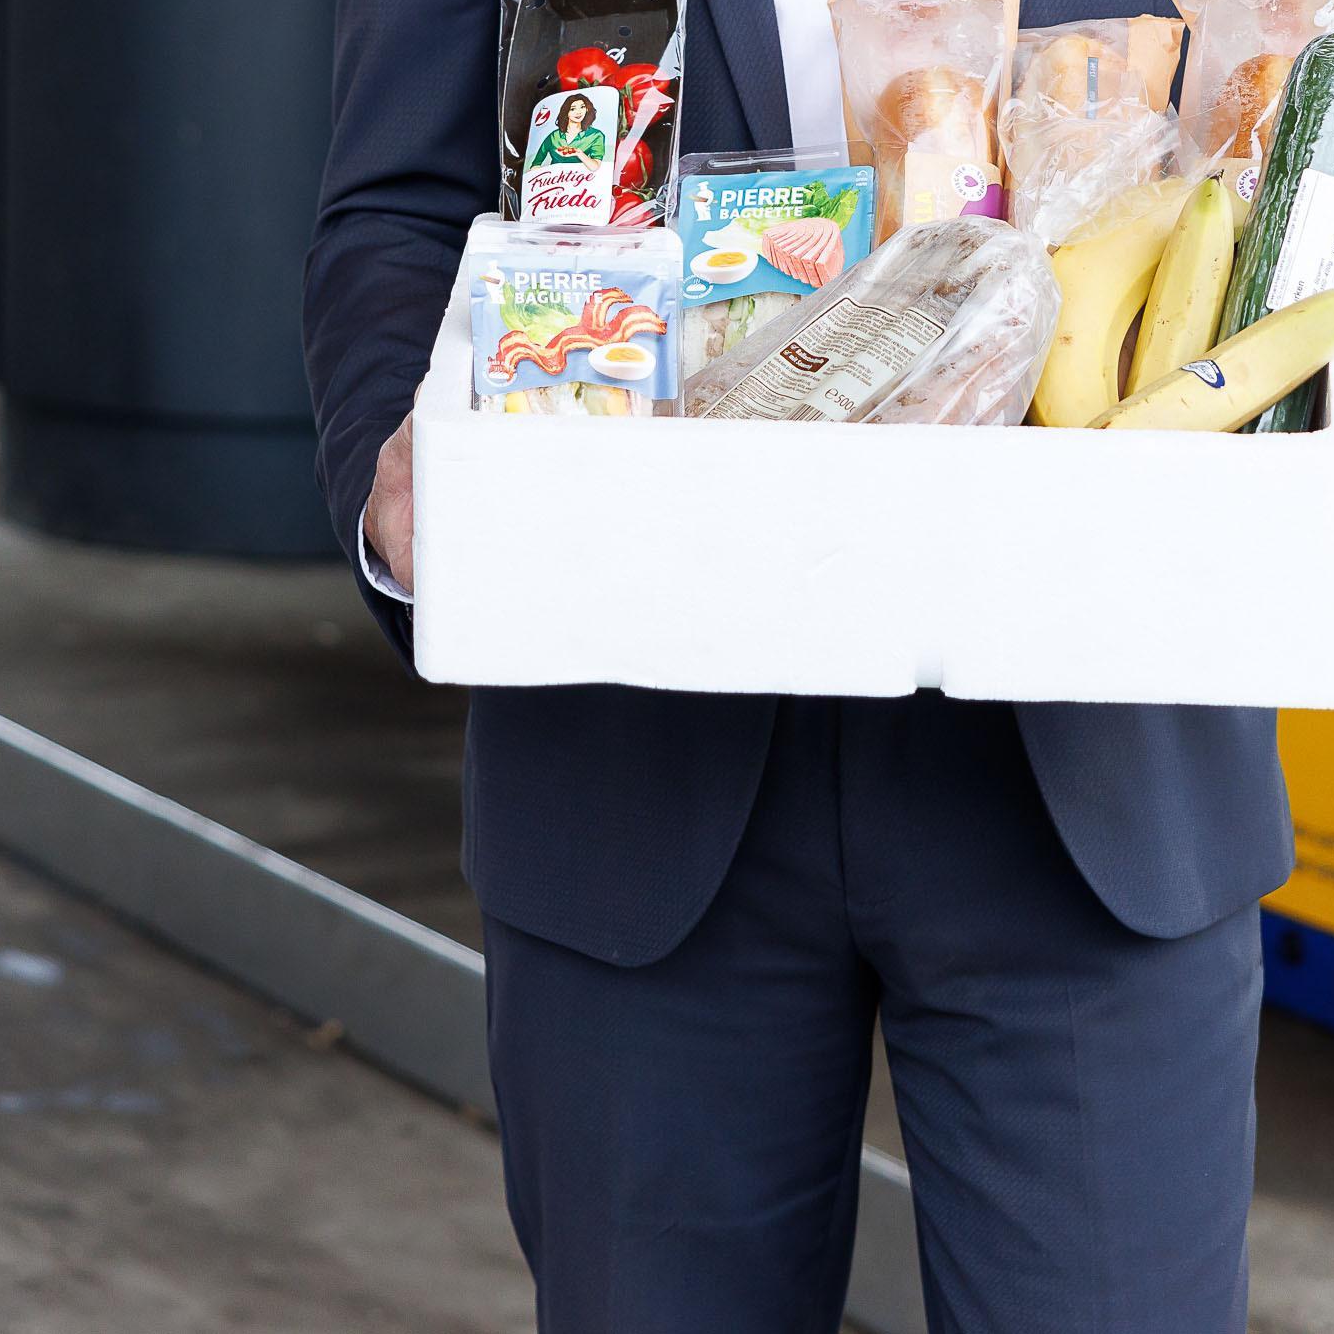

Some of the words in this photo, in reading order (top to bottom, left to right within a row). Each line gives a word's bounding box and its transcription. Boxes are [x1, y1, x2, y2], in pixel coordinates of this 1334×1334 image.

[1237, 169, 1254, 200] FRISCHER
[528, 187, 602, 217] Frieda
[720, 186, 805, 207] PIERRE
[719, 206, 803, 220] BAGUETTE
[513, 272, 604, 291] PIERRE
[513, 291, 605, 304] BAGUETTE
